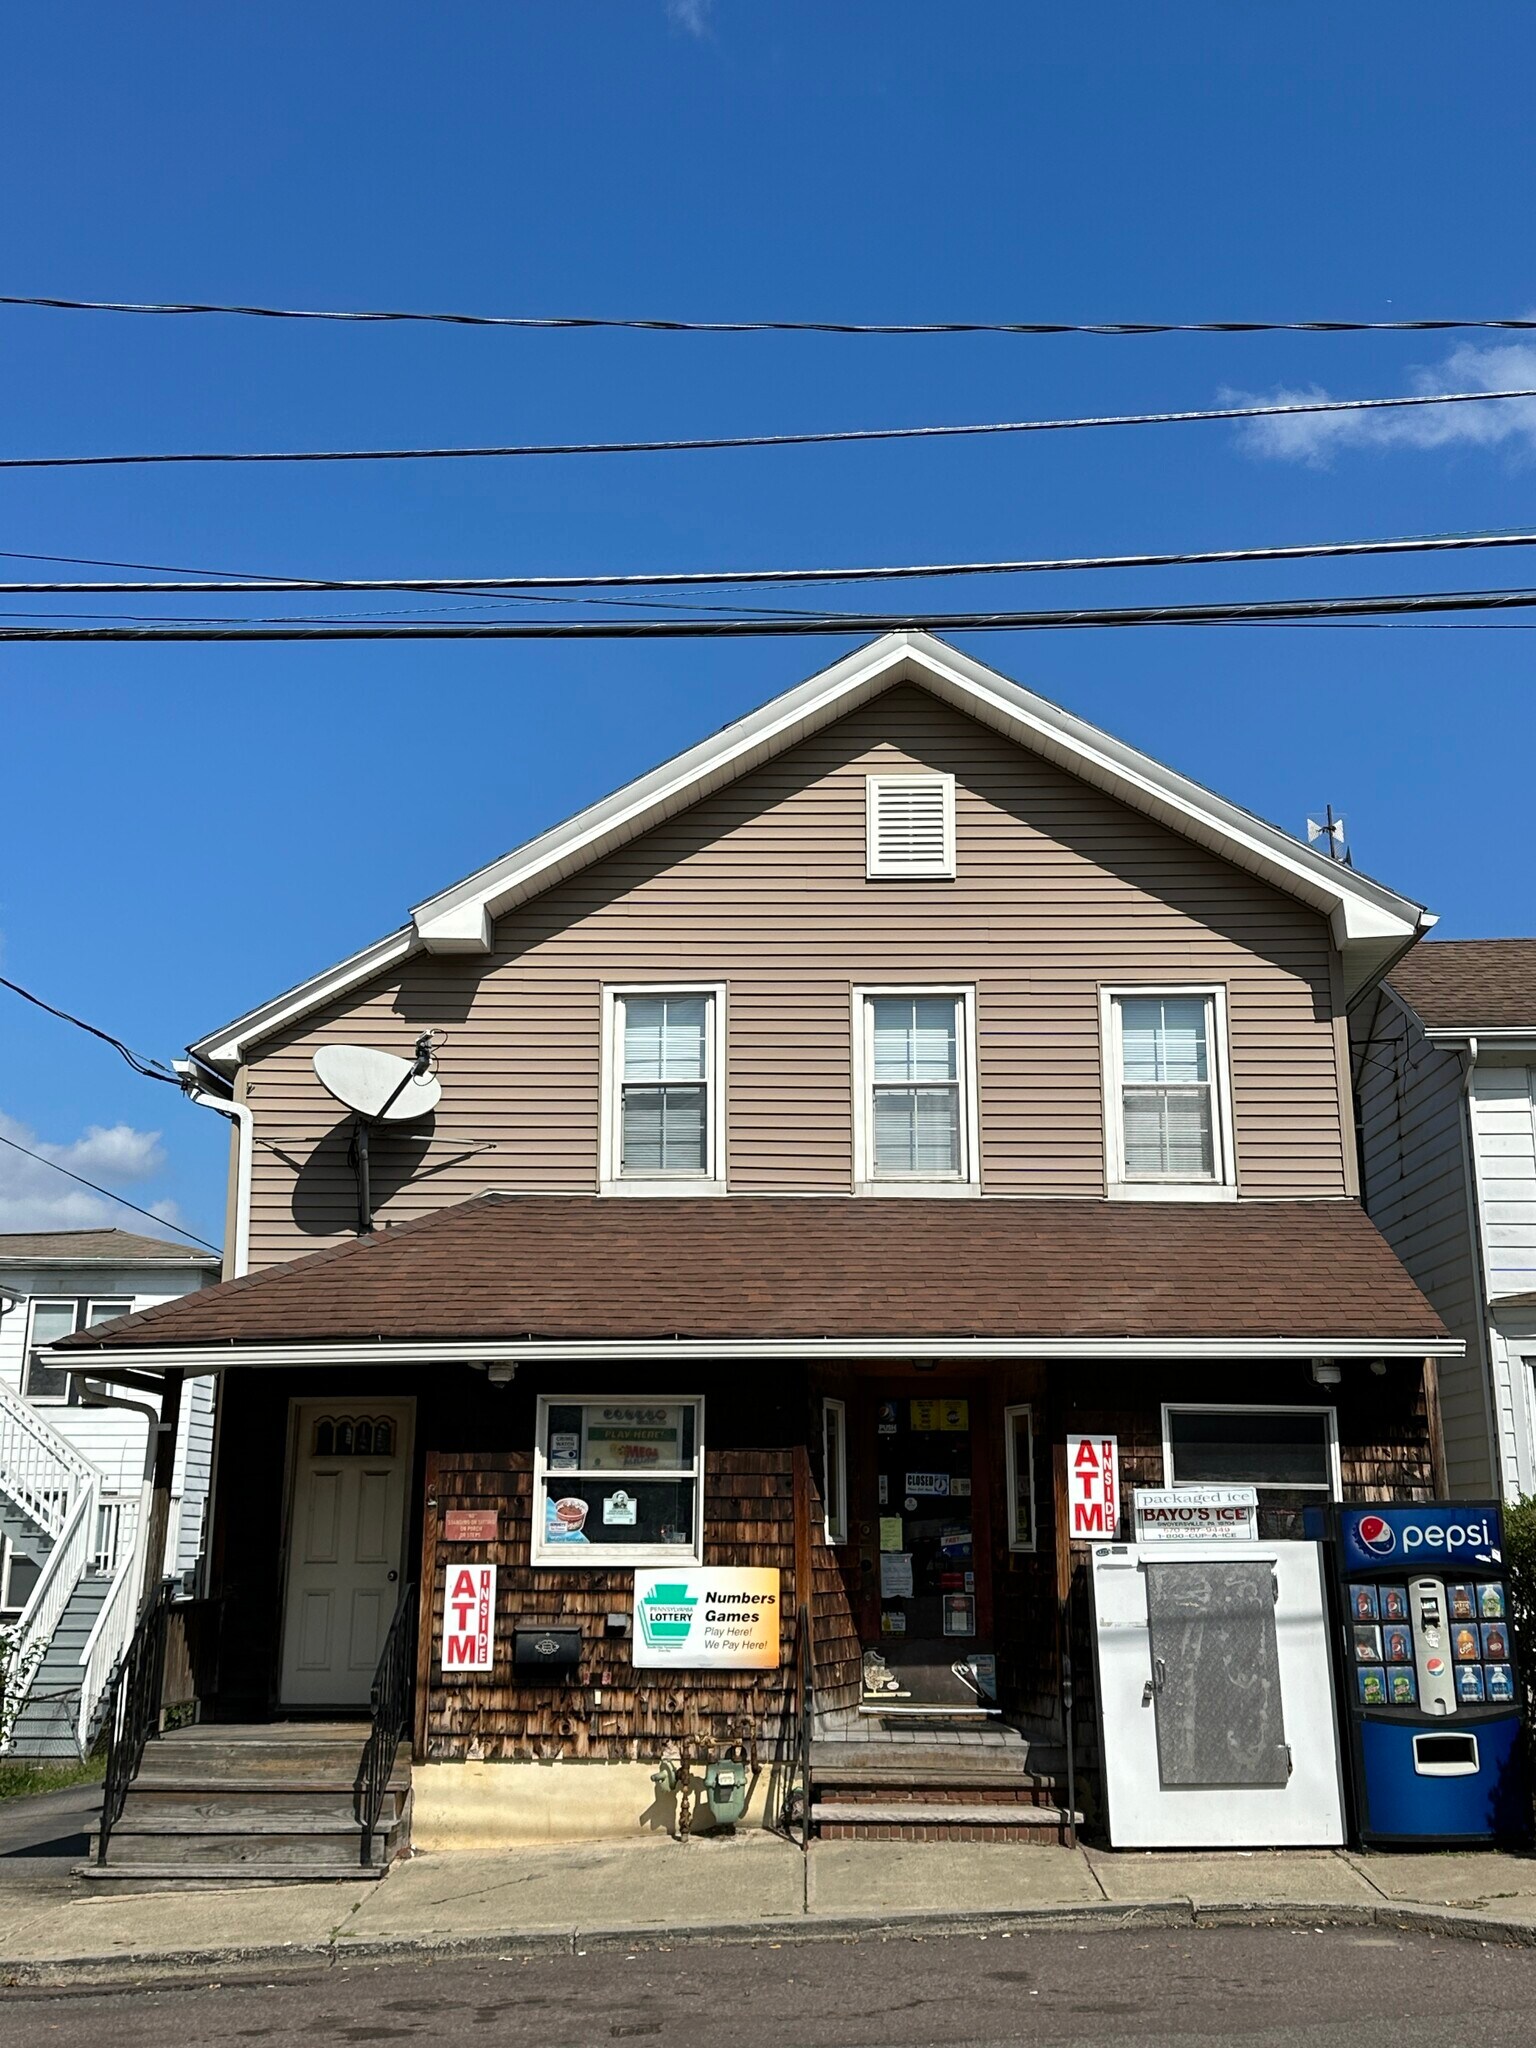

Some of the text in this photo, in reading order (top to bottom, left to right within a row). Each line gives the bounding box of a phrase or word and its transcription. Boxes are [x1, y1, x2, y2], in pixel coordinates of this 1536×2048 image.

[908, 1475, 933, 1486] CLOSED
[1074, 1440, 1103, 1531] ATM
[1103, 1442, 1114, 1530] INSIDE
[1143, 1492, 1250, 1506] packaged ice
[1144, 1507, 1247, 1521] BAYO'S ICE
[1402, 1519, 1489, 1553] pepsi
[705, 1592, 776, 1604] Numbers
[447, 1570, 477, 1664] ATM
[478, 1572, 489, 1662] INSIDE
[650, 1613, 693, 1622] LOTTERY
[705, 1610, 760, 1622] Games
[704, 1627, 753, 1638] Play Here!
[705, 1640, 768, 1651] We Pay Here!
